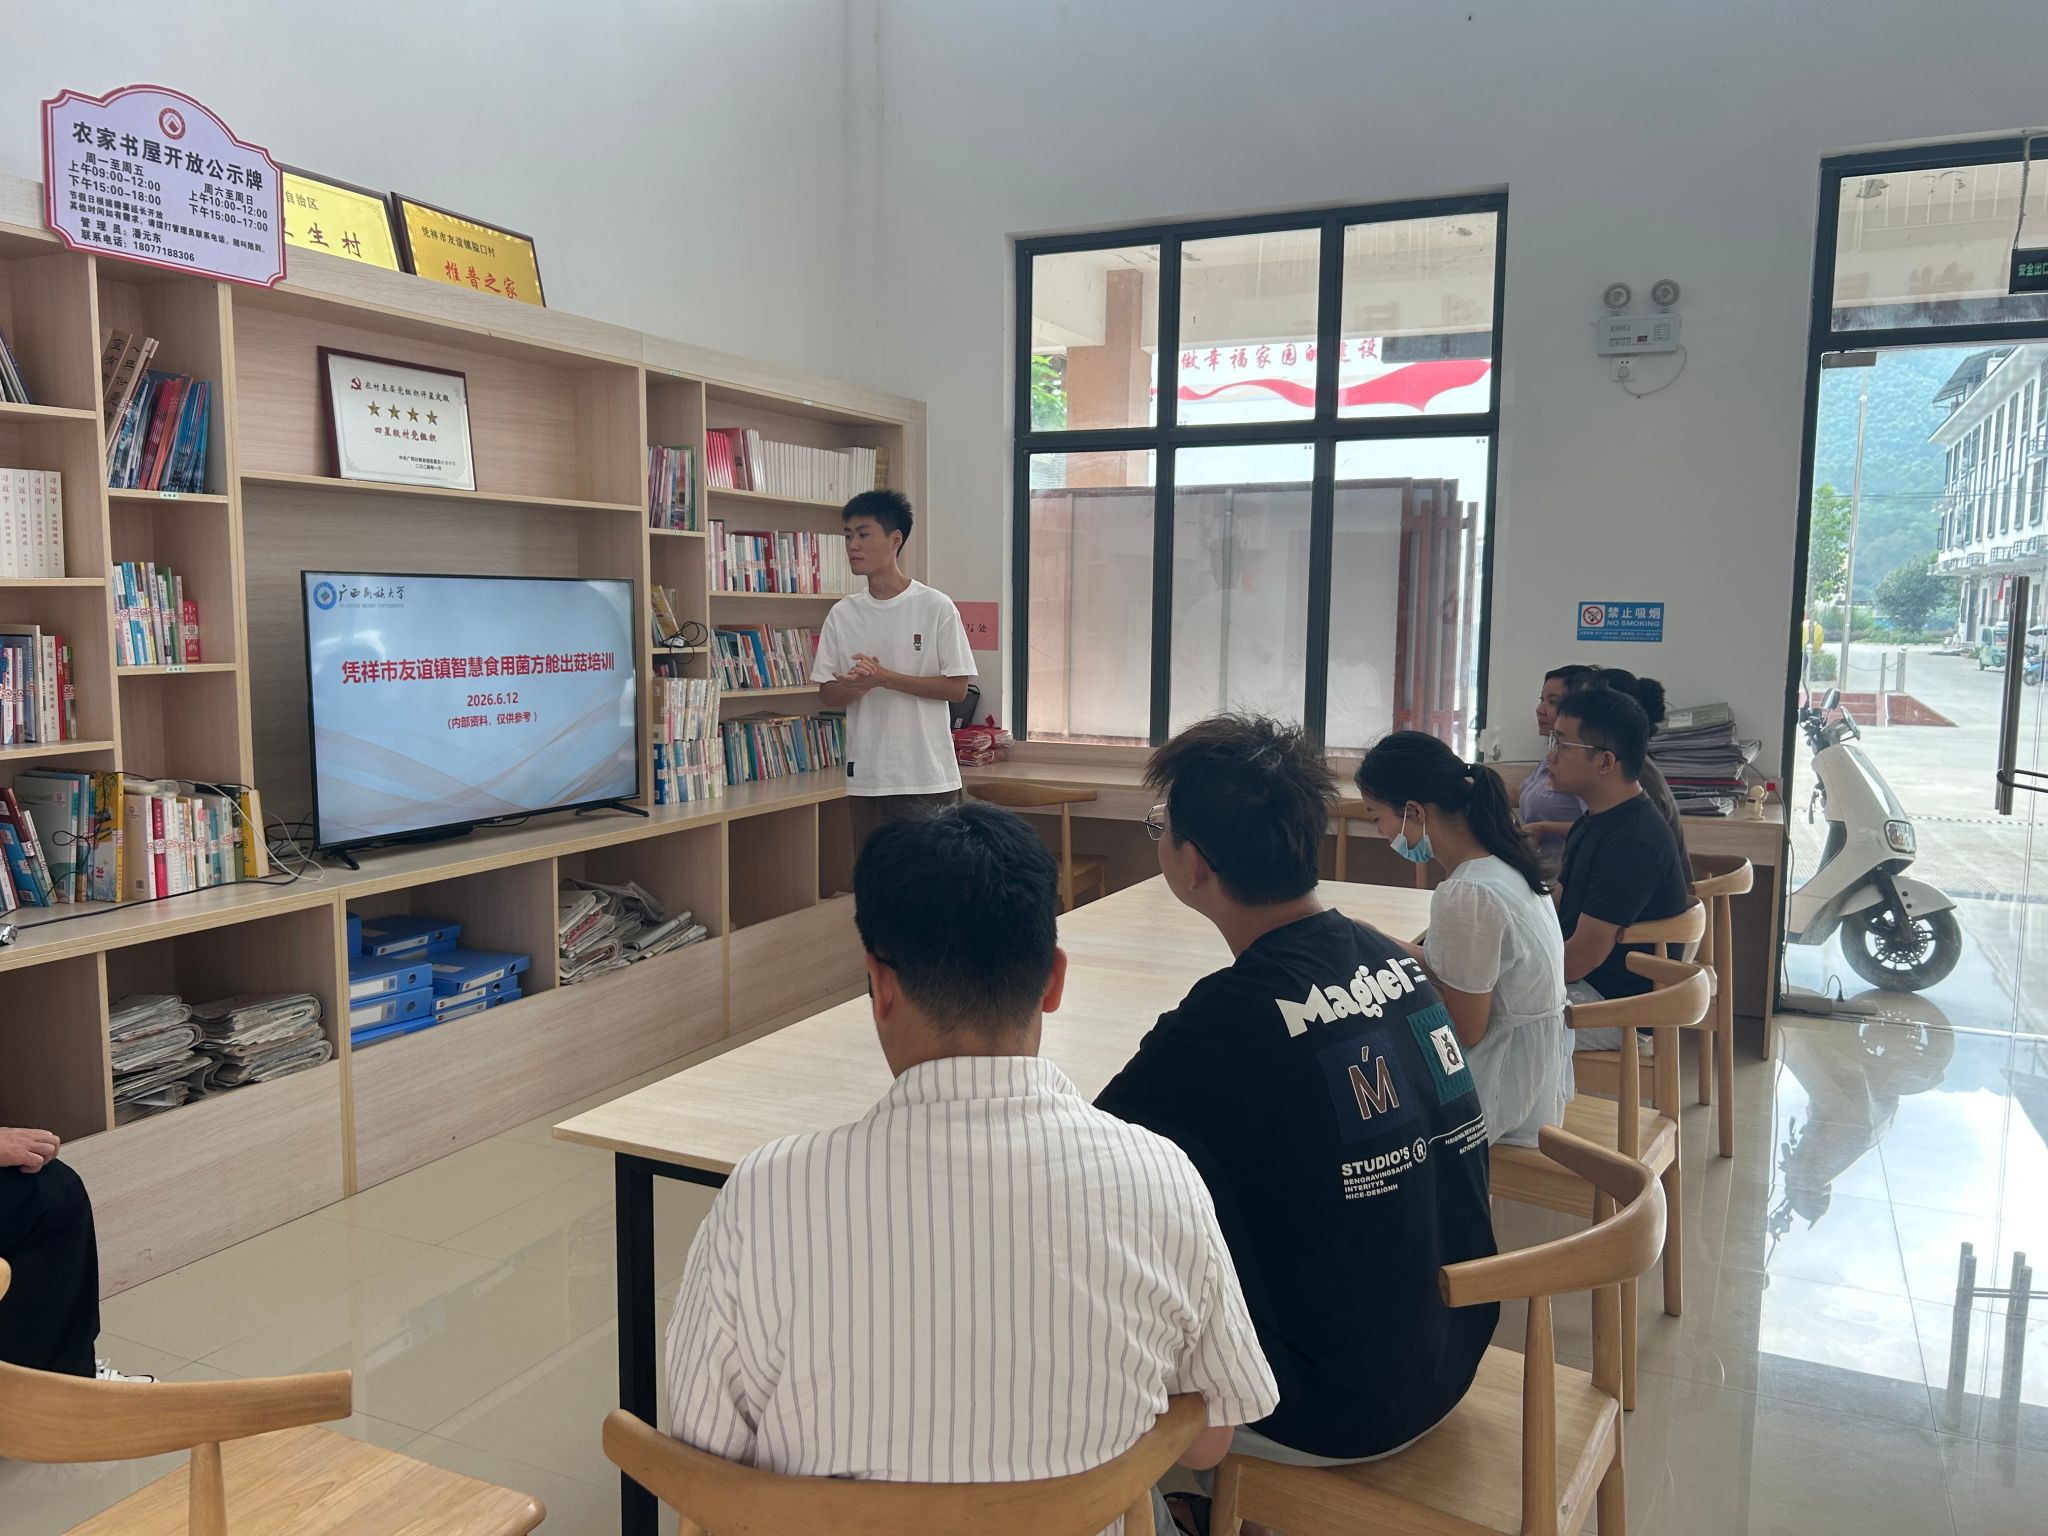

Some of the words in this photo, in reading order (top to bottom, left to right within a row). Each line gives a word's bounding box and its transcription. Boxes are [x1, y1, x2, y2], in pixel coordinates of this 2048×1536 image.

[72, 121, 264, 192] 农家书屋开放公示牌
[85, 151, 145, 177] 周一至周五
[68, 160, 161, 193] 上午09:00-12:00
[68, 174, 162, 206] 下午15:00-18:00
[69, 189, 164, 220] 节假日根据需要延长开放
[188, 190, 268, 220] 上午10:00-12:00
[203, 182, 254, 206] 周六至周日
[188, 203, 269, 233] 下午15:00-17:00
[284, 218, 362, 258] 生村
[444, 259, 519, 299] 推普之家
[374, 426, 437, 443] 四星级村党组织
[1607, 606, 1661, 619] 禁止吸烟
[341, 651, 615, 685] 凭祥市友谊镇智慧食用菌方舱出菇培训
[466, 692, 519, 708] 2026.6.12
[1275, 958, 1415, 1038] Magiel
[1341, 1146, 1410, 1177] STUDIO'S
